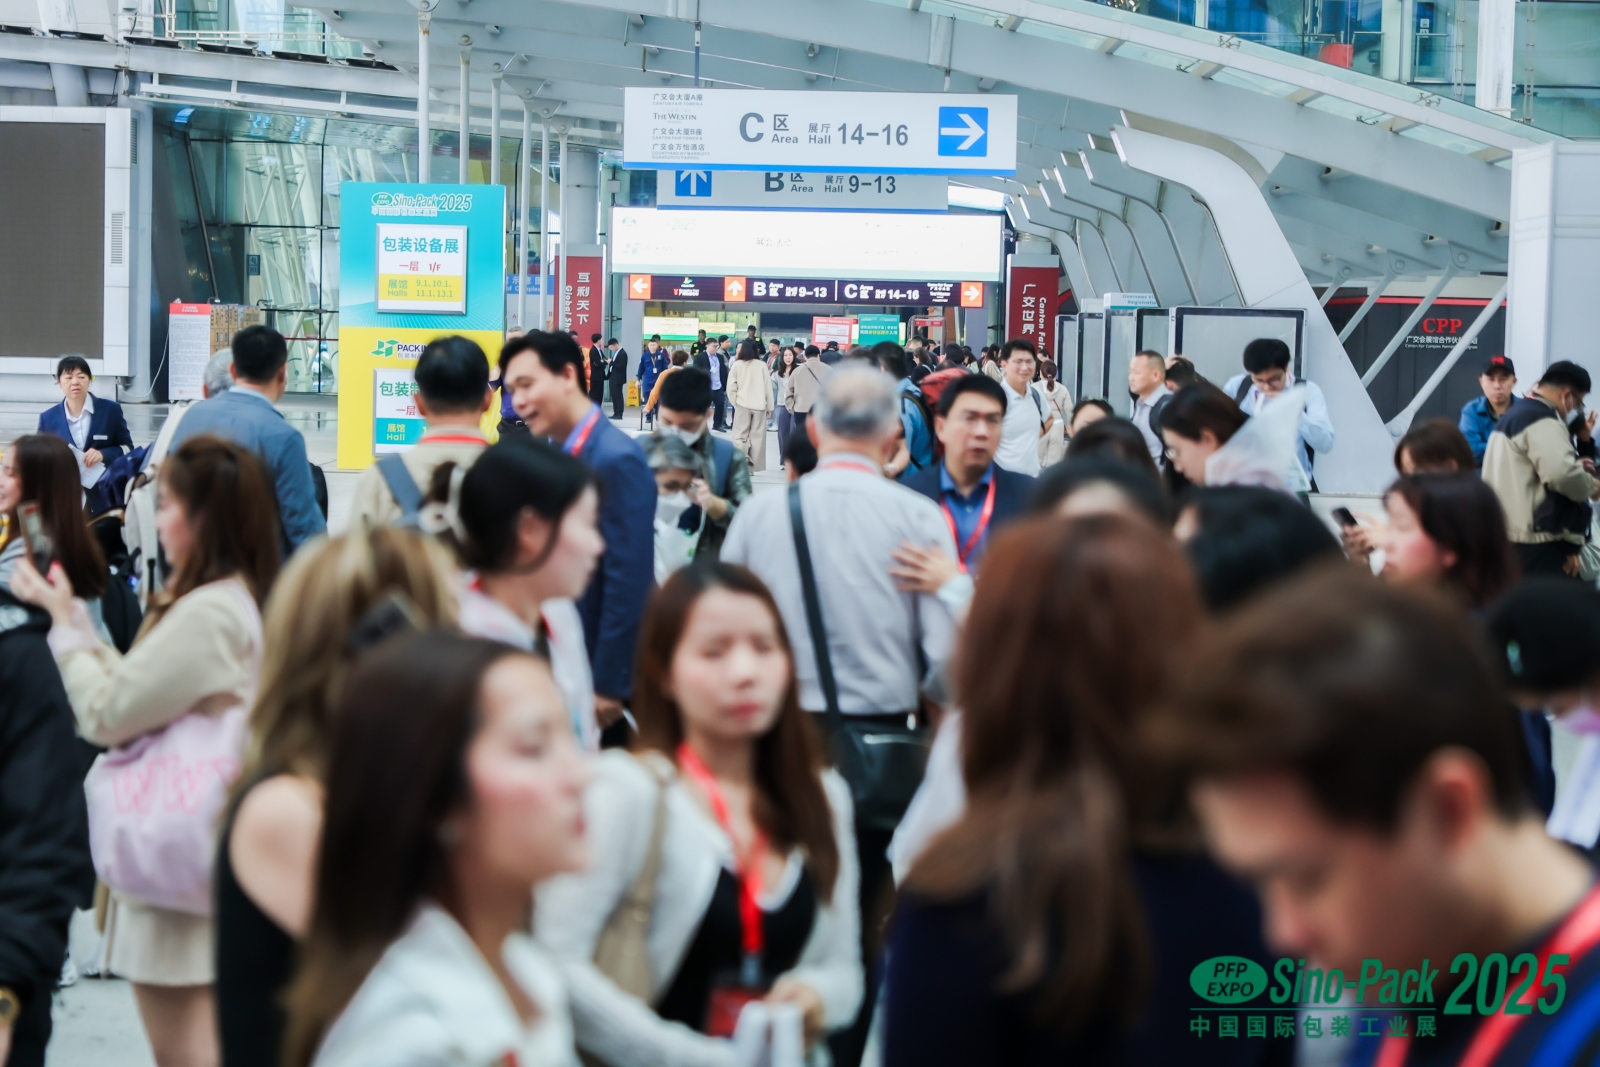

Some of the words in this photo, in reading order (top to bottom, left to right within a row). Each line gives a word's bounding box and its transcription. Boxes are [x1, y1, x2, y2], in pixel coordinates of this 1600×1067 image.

[740, 112, 764, 142] C
[773, 114, 789, 131] 区
[808, 123, 831, 133] 展厅
[771, 134, 798, 144] Area
[808, 135, 830, 144] Hall
[838, 123, 908, 146] 14-16
[764, 172, 784, 192] B
[790, 173, 804, 182] 区
[825, 175, 844, 184] 展厅
[791, 184, 813, 192] Area
[849, 175, 896, 194] 9-13
[393, 193, 438, 207] Sino-Pack
[439, 194, 472, 212] 2025
[383, 236, 459, 254] 包装设备展
[399, 261, 419, 271] 一层
[429, 262, 441, 272] 1/F
[388, 279, 408, 289] 展馆
[753, 282, 767, 296] B
[799, 286, 827, 298] 9-13
[844, 284, 858, 299] C
[888, 289, 919, 300] 14-16
[577, 272, 590, 325] 互利天下
[1022, 284, 1036, 334] 广交世界
[1422, 318, 1462, 334] CPP
[396, 406, 415, 416] 一层
[387, 423, 406, 432] 展馆
